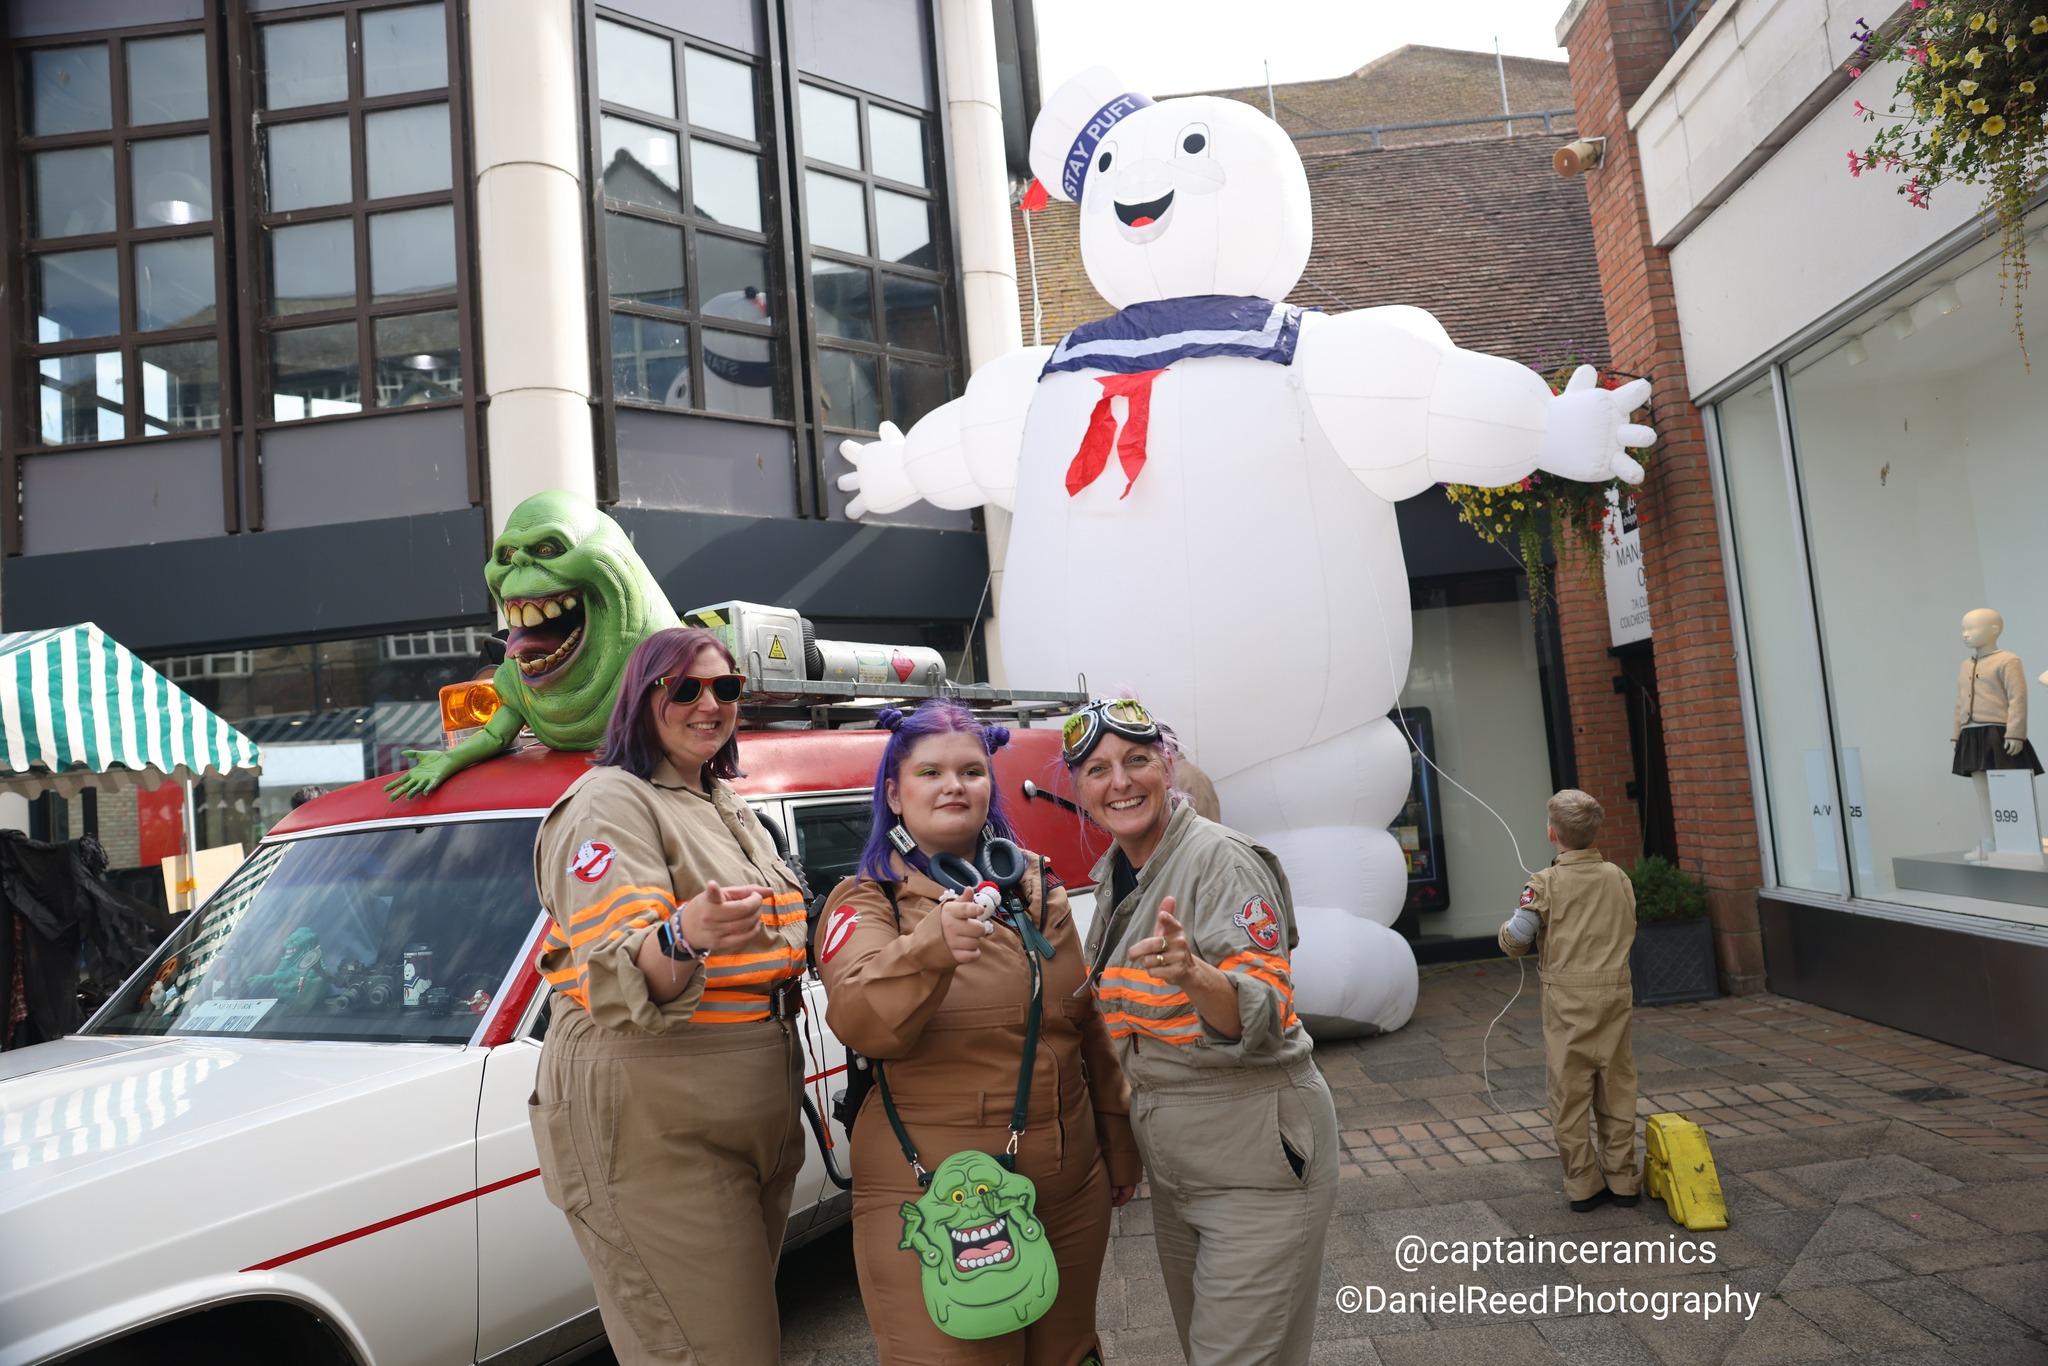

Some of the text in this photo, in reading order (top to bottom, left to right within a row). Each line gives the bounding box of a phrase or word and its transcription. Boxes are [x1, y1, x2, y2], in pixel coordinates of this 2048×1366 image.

[1064, 96, 1137, 197] STAY PUFT
[1994, 809, 2018, 823] 9.99
